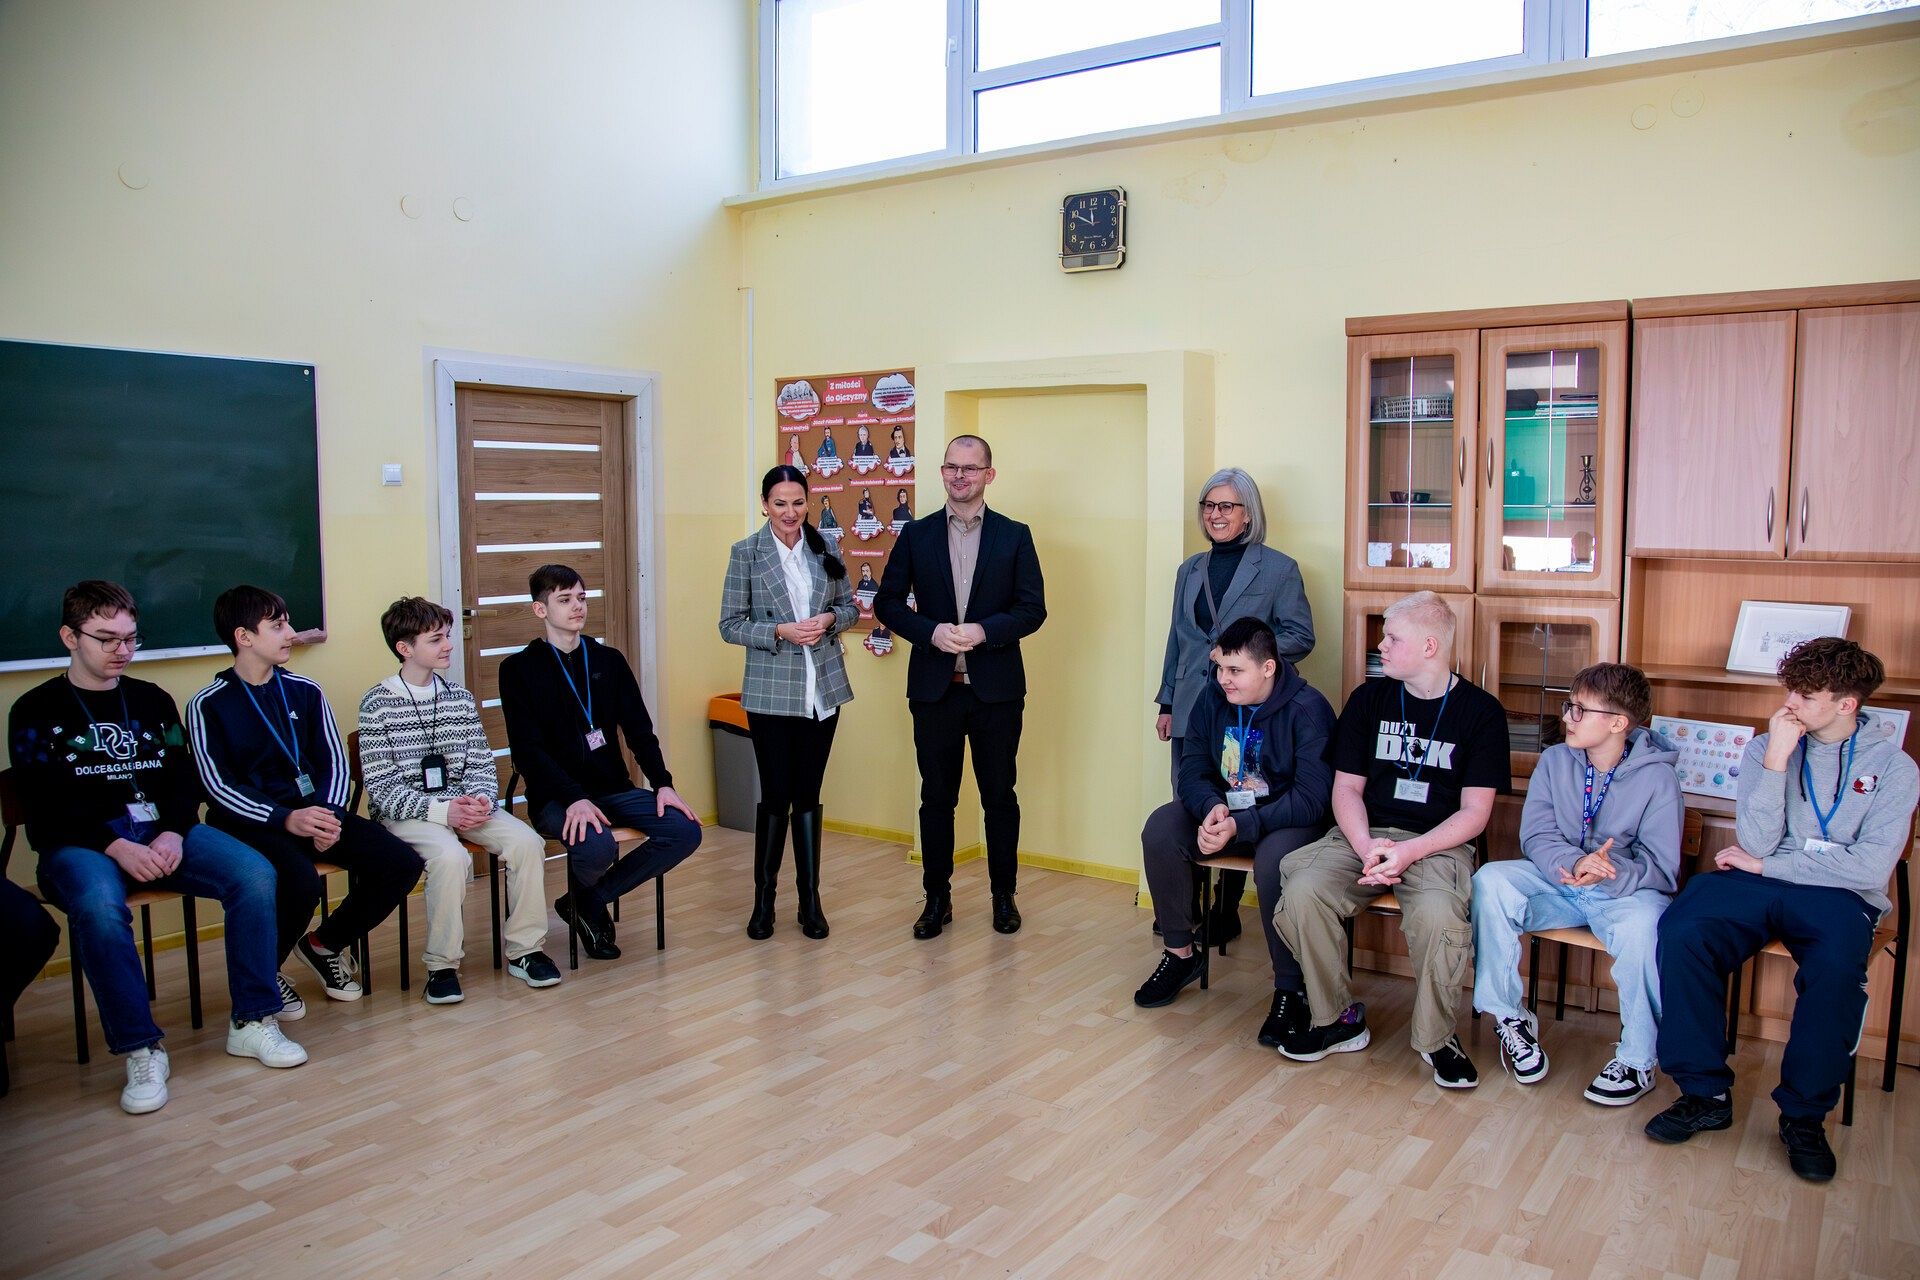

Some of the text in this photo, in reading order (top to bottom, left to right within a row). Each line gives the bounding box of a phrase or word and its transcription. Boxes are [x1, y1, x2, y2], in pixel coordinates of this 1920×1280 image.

[1090, 198, 1098, 206] 12
[1110, 205, 1115, 213] 2
[1071, 210, 1079, 218] 10
[1111, 217, 1116, 226] 3
[1070, 222, 1076, 230] 9
[1109, 230, 1114, 238] 4
[1080, 241, 1085, 249] 7
[1090, 241, 1095, 249] 6
[1101, 238, 1107, 246] 5
[835, 380, 861, 390] miłości
[825, 394, 834, 402] do
[835, 393, 867, 403] Ojczyzny
[1379, 720, 1416, 736] DUŻY
